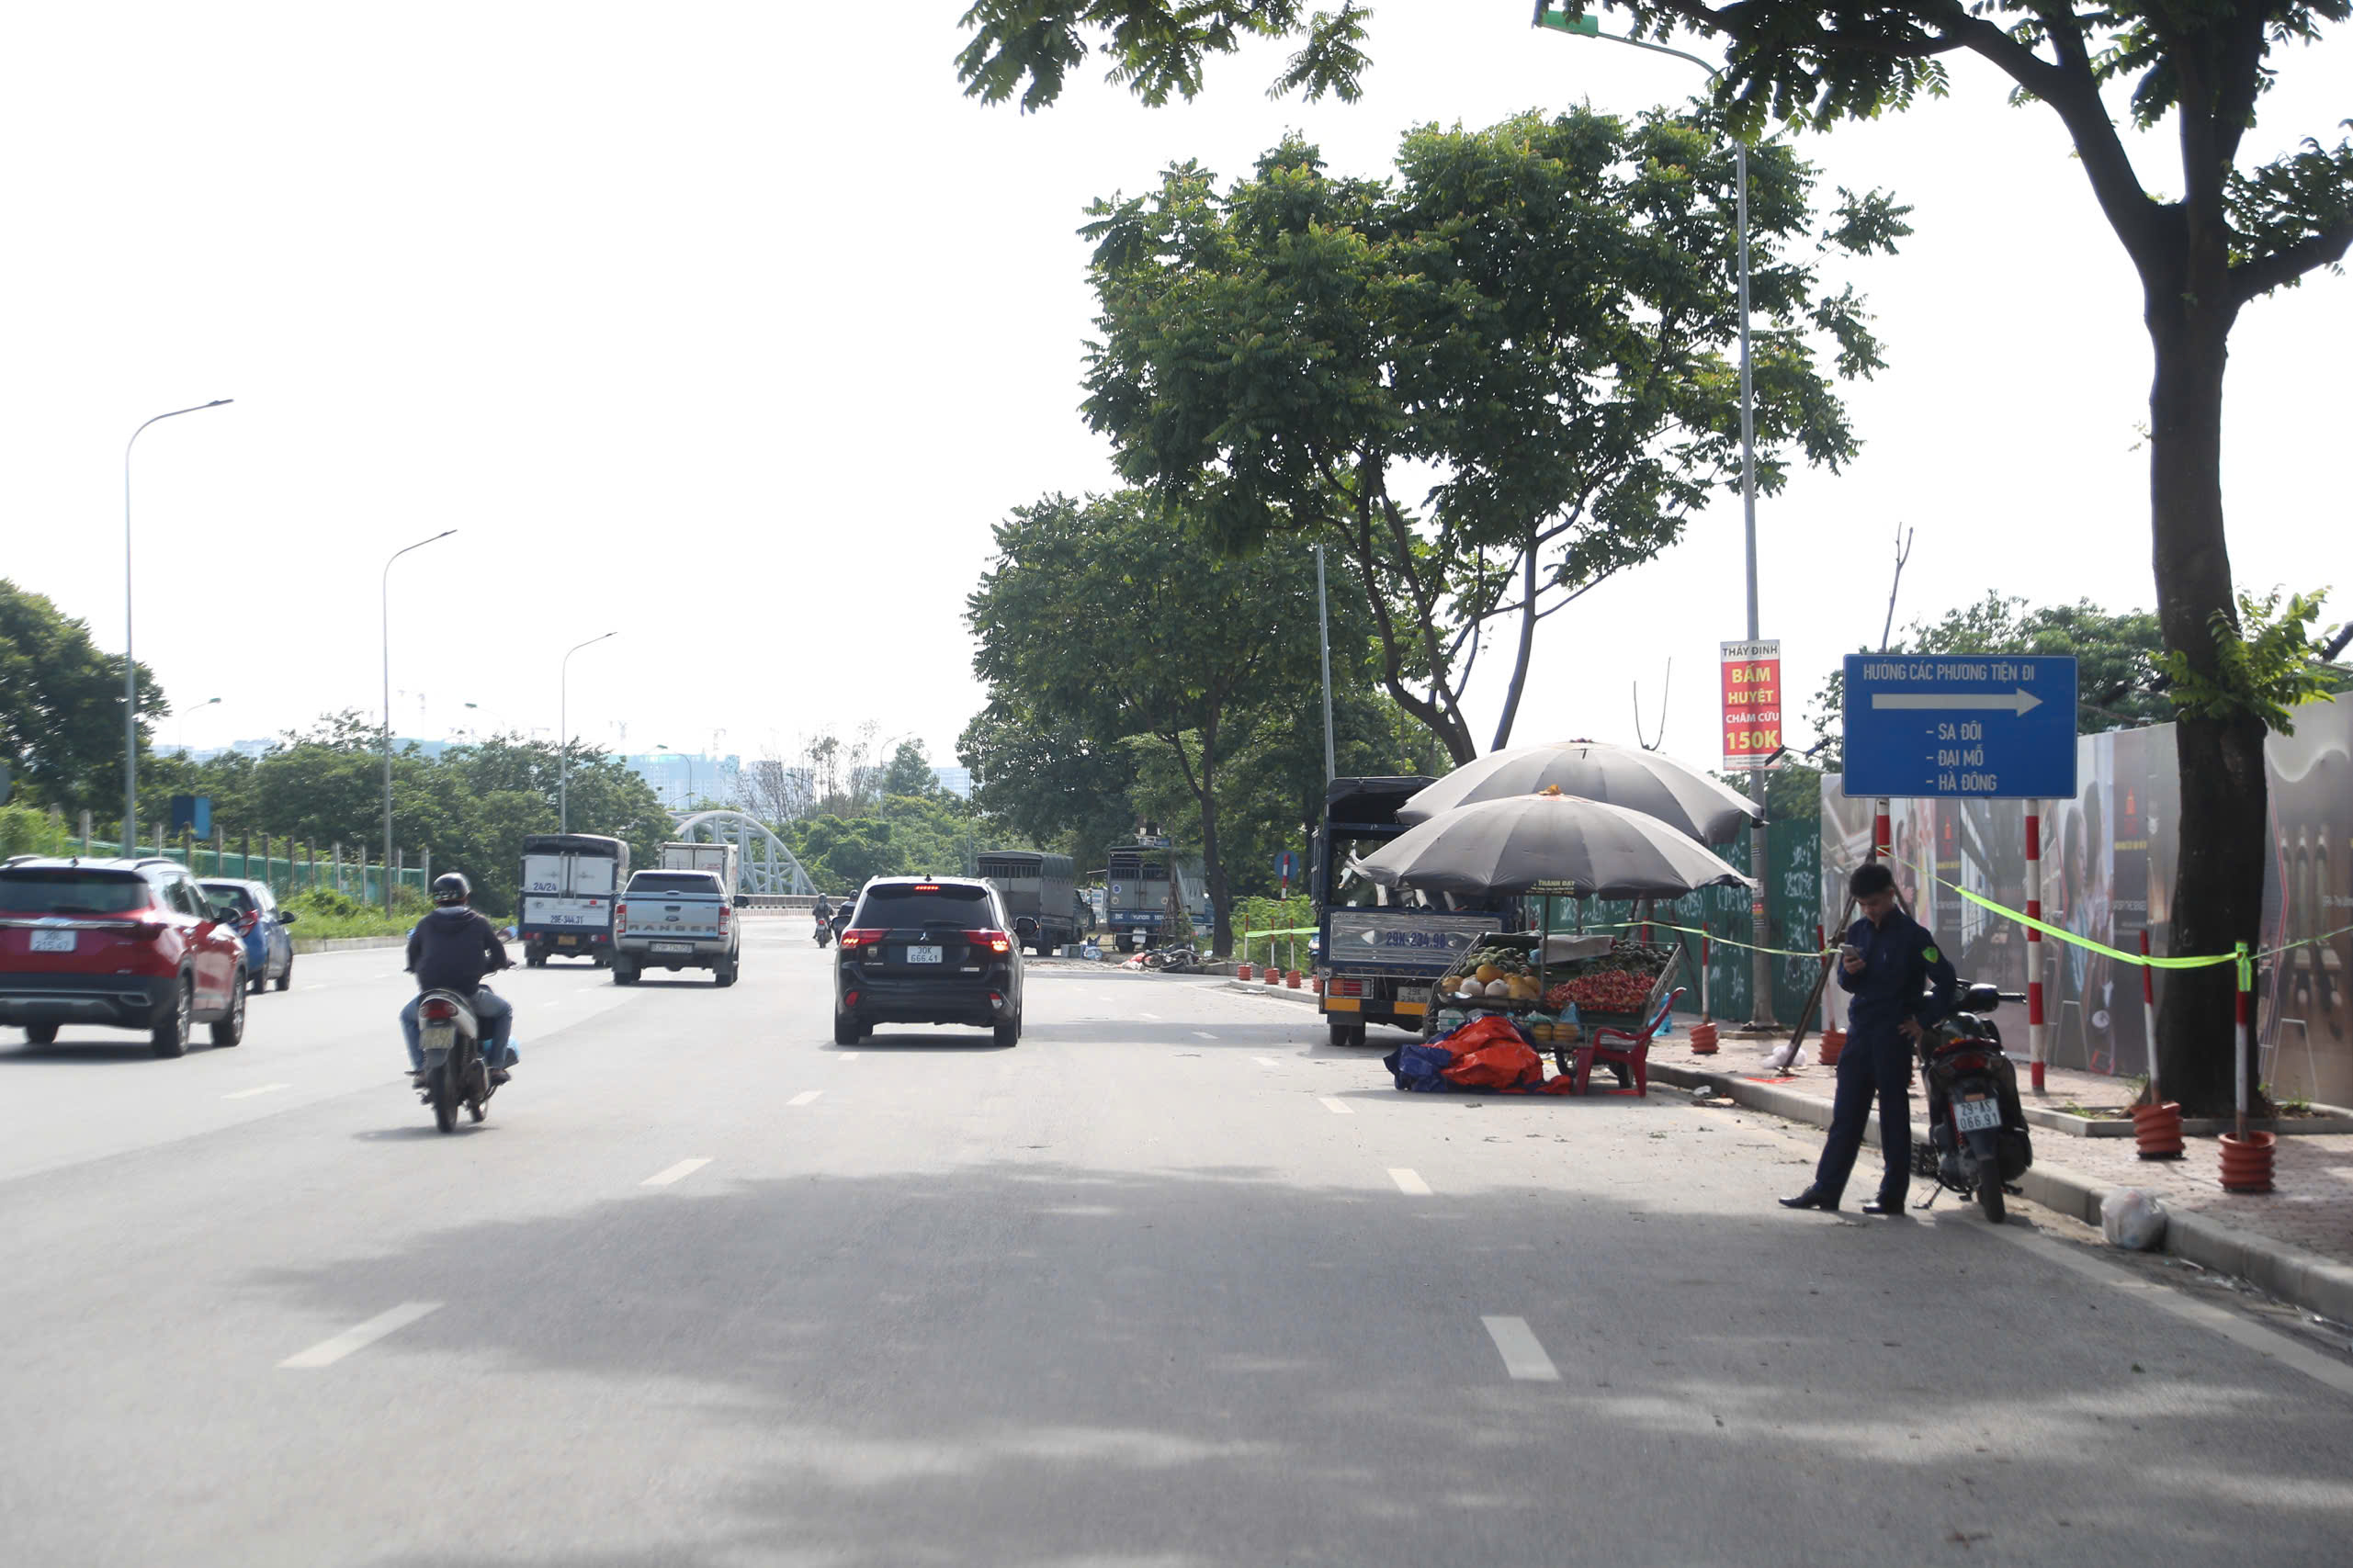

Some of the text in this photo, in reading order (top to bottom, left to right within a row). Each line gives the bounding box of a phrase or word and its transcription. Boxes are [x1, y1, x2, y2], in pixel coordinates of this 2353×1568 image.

[1732, 663, 1771, 683] BẤM
[1910, 660, 1934, 680] CÁC
[1991, 660, 2018, 683] TIỆN
[2022, 664, 2035, 681] ĐI
[1728, 688, 1774, 705] HUYỆT
[1726, 711, 1779, 724] CHÂM CỨU
[1727, 729, 1779, 750] 150K
[1939, 723, 1956, 740] SA
[1961, 719, 1982, 740] ĐÔI
[1938, 749, 1960, 769] ĐẠI
[1963, 744, 1984, 766] MỖ
[1939, 771, 1957, 791] HÀ
[1961, 772, 1997, 791] ĐÔNG
[533, 882, 557, 892] 24/24
[918, 946, 932, 954] 30K
[1960, 1112, 1998, 1130] 066.91
